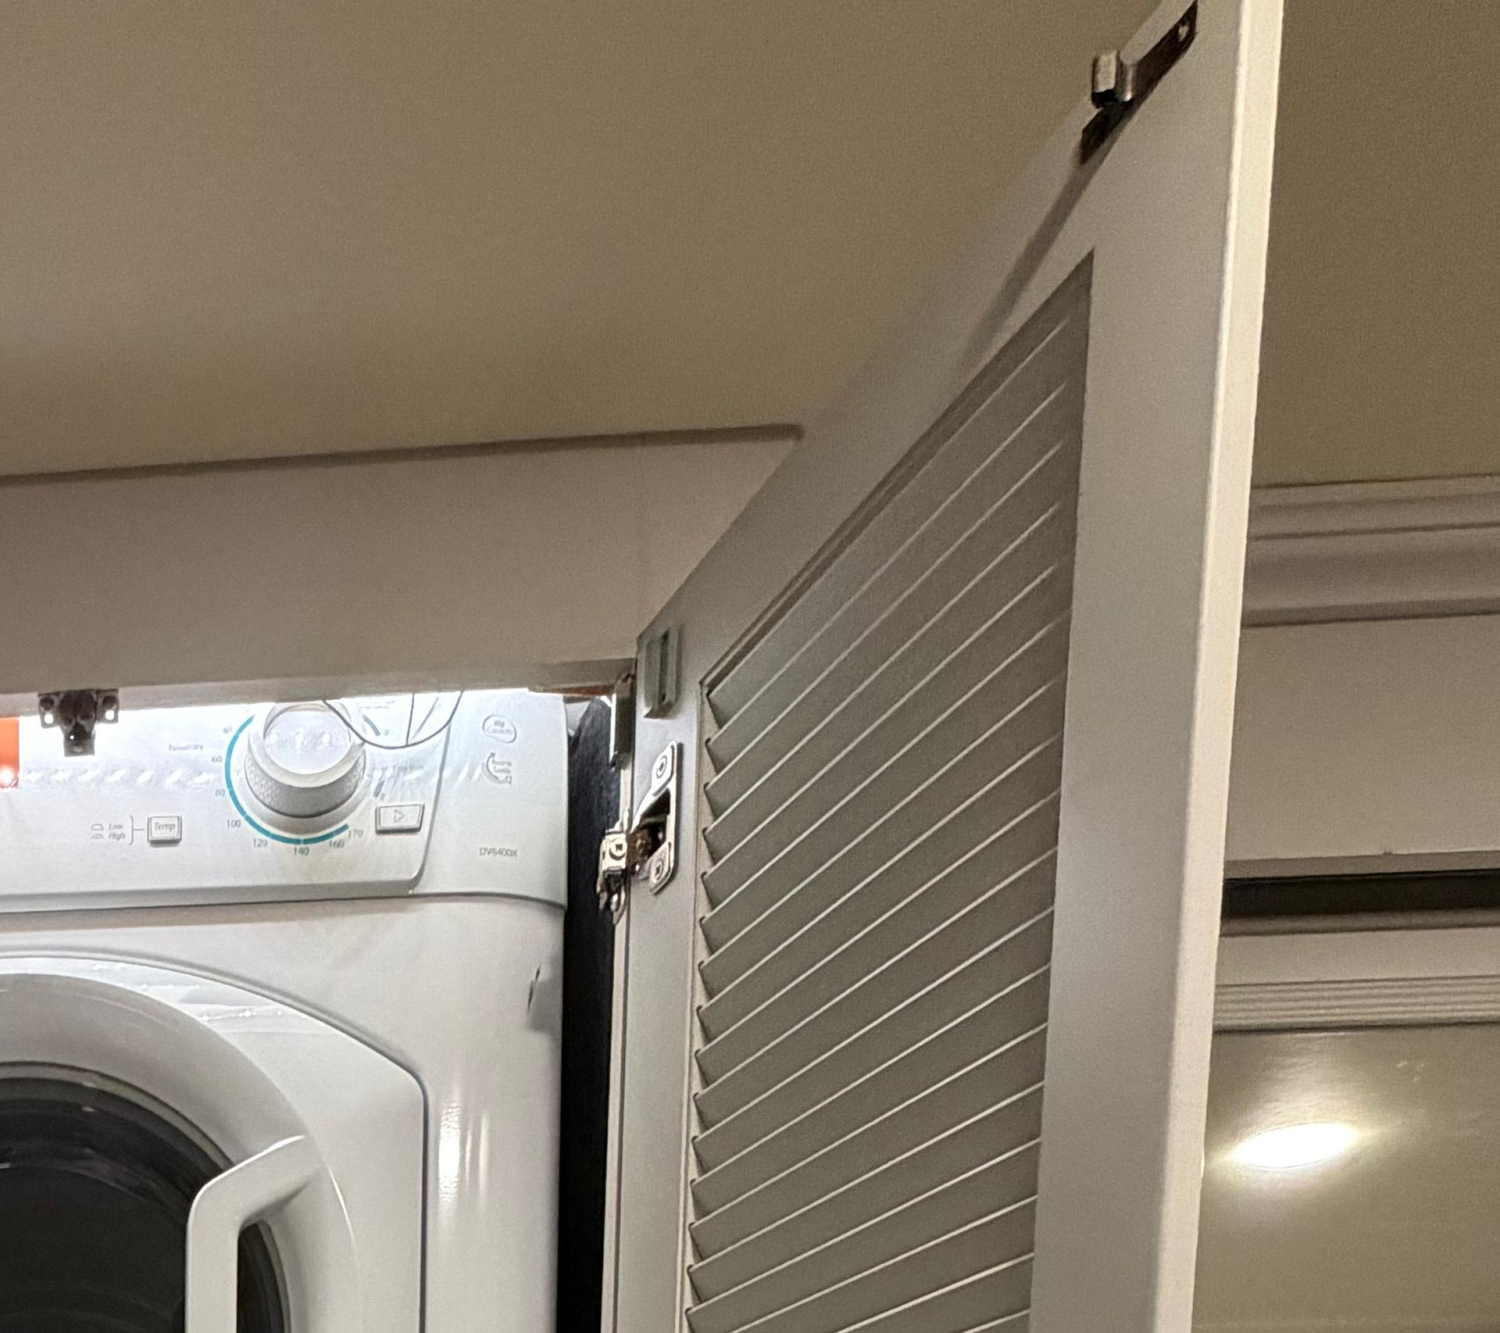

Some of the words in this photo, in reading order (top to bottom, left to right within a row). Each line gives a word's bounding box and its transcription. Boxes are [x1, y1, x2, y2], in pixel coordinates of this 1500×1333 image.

[154, 822, 176, 832] Temp
[226, 820, 242, 829] 100
[253, 838, 268, 848] 120
[293, 846, 309, 857] 140
